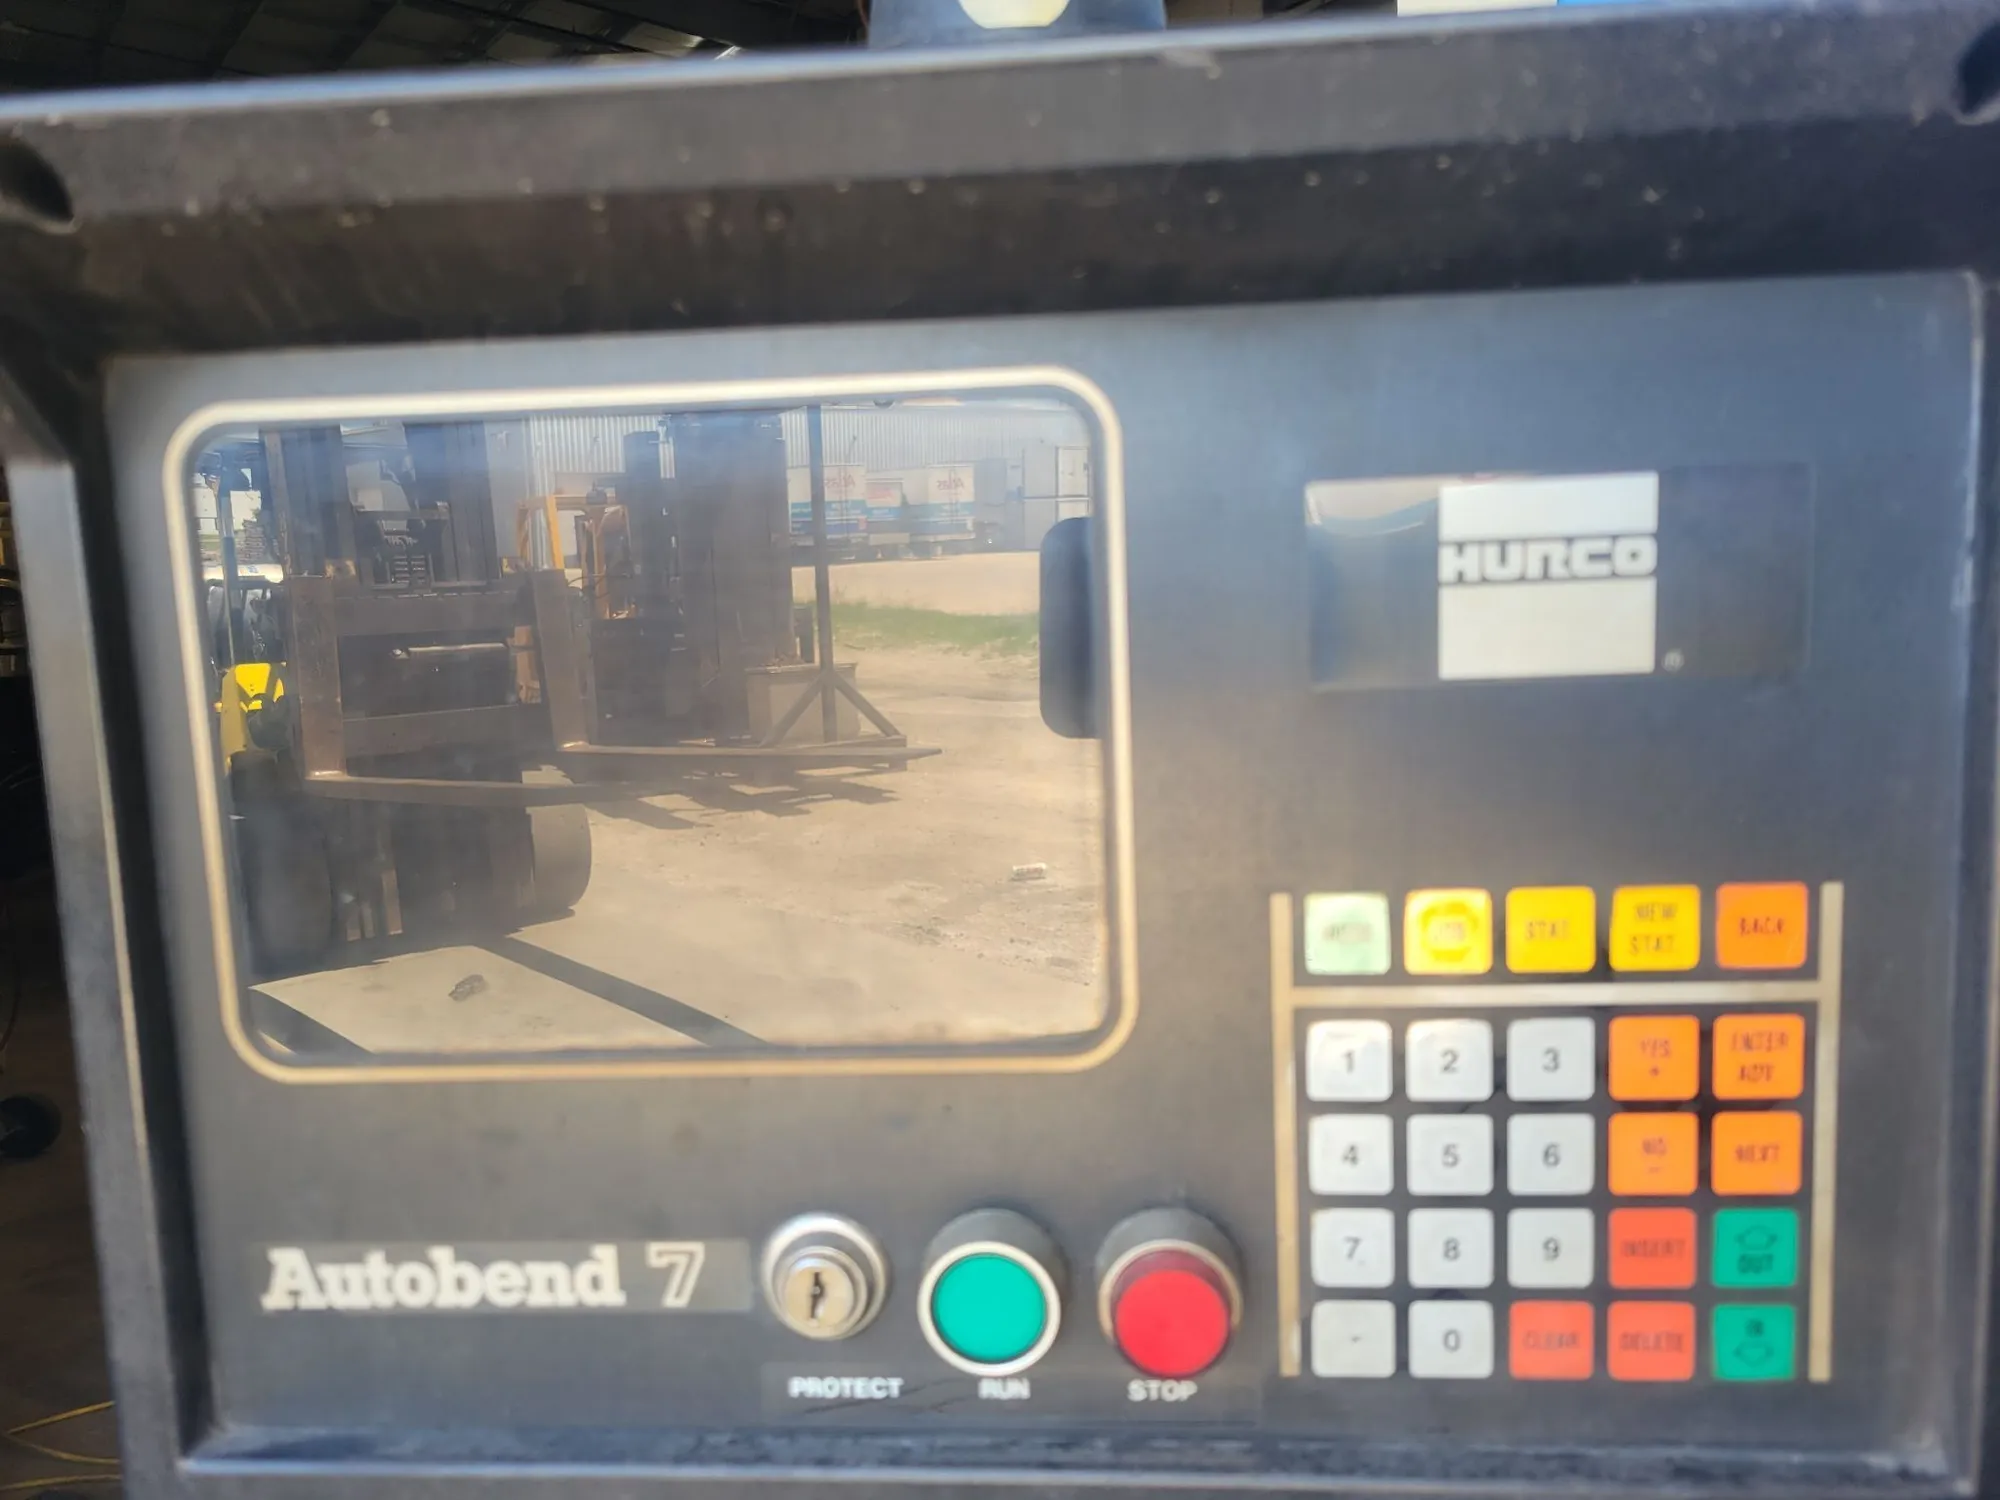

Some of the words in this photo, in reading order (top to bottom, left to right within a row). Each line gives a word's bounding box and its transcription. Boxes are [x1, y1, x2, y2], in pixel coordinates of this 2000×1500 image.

[1438, 535, 1658, 583] HURCO
[1737, 915, 1787, 938] BACK
[1729, 1031, 1790, 1054] ENTER
[1341, 1051, 1357, 1073] 1
[1440, 1049, 1460, 1074] 2
[1542, 1048, 1561, 1074] 3
[1341, 1144, 1361, 1168] 4
[1441, 1144, 1460, 1168] 5
[1541, 1143, 1561, 1169] 6
[1734, 1143, 1781, 1165] NEXT
[1344, 1237, 1362, 1261] 7
[1442, 1237, 1461, 1262] 8
[1541, 1237, 1561, 1262] 9
[1620, 1236, 1686, 1260] INSERT
[1737, 1252, 1775, 1275] OUT
[260, 1244, 626, 1312] Autobend
[645, 1241, 706, 1308] 7
[1443, 1328, 1461, 1354] 0
[1521, 1330, 1580, 1351] CLEAR
[1620, 1329, 1685, 1353] DELETE
[788, 1375, 903, 1400] PROTECT
[978, 1377, 1031, 1400] RUN
[1127, 1378, 1199, 1403] STOP
